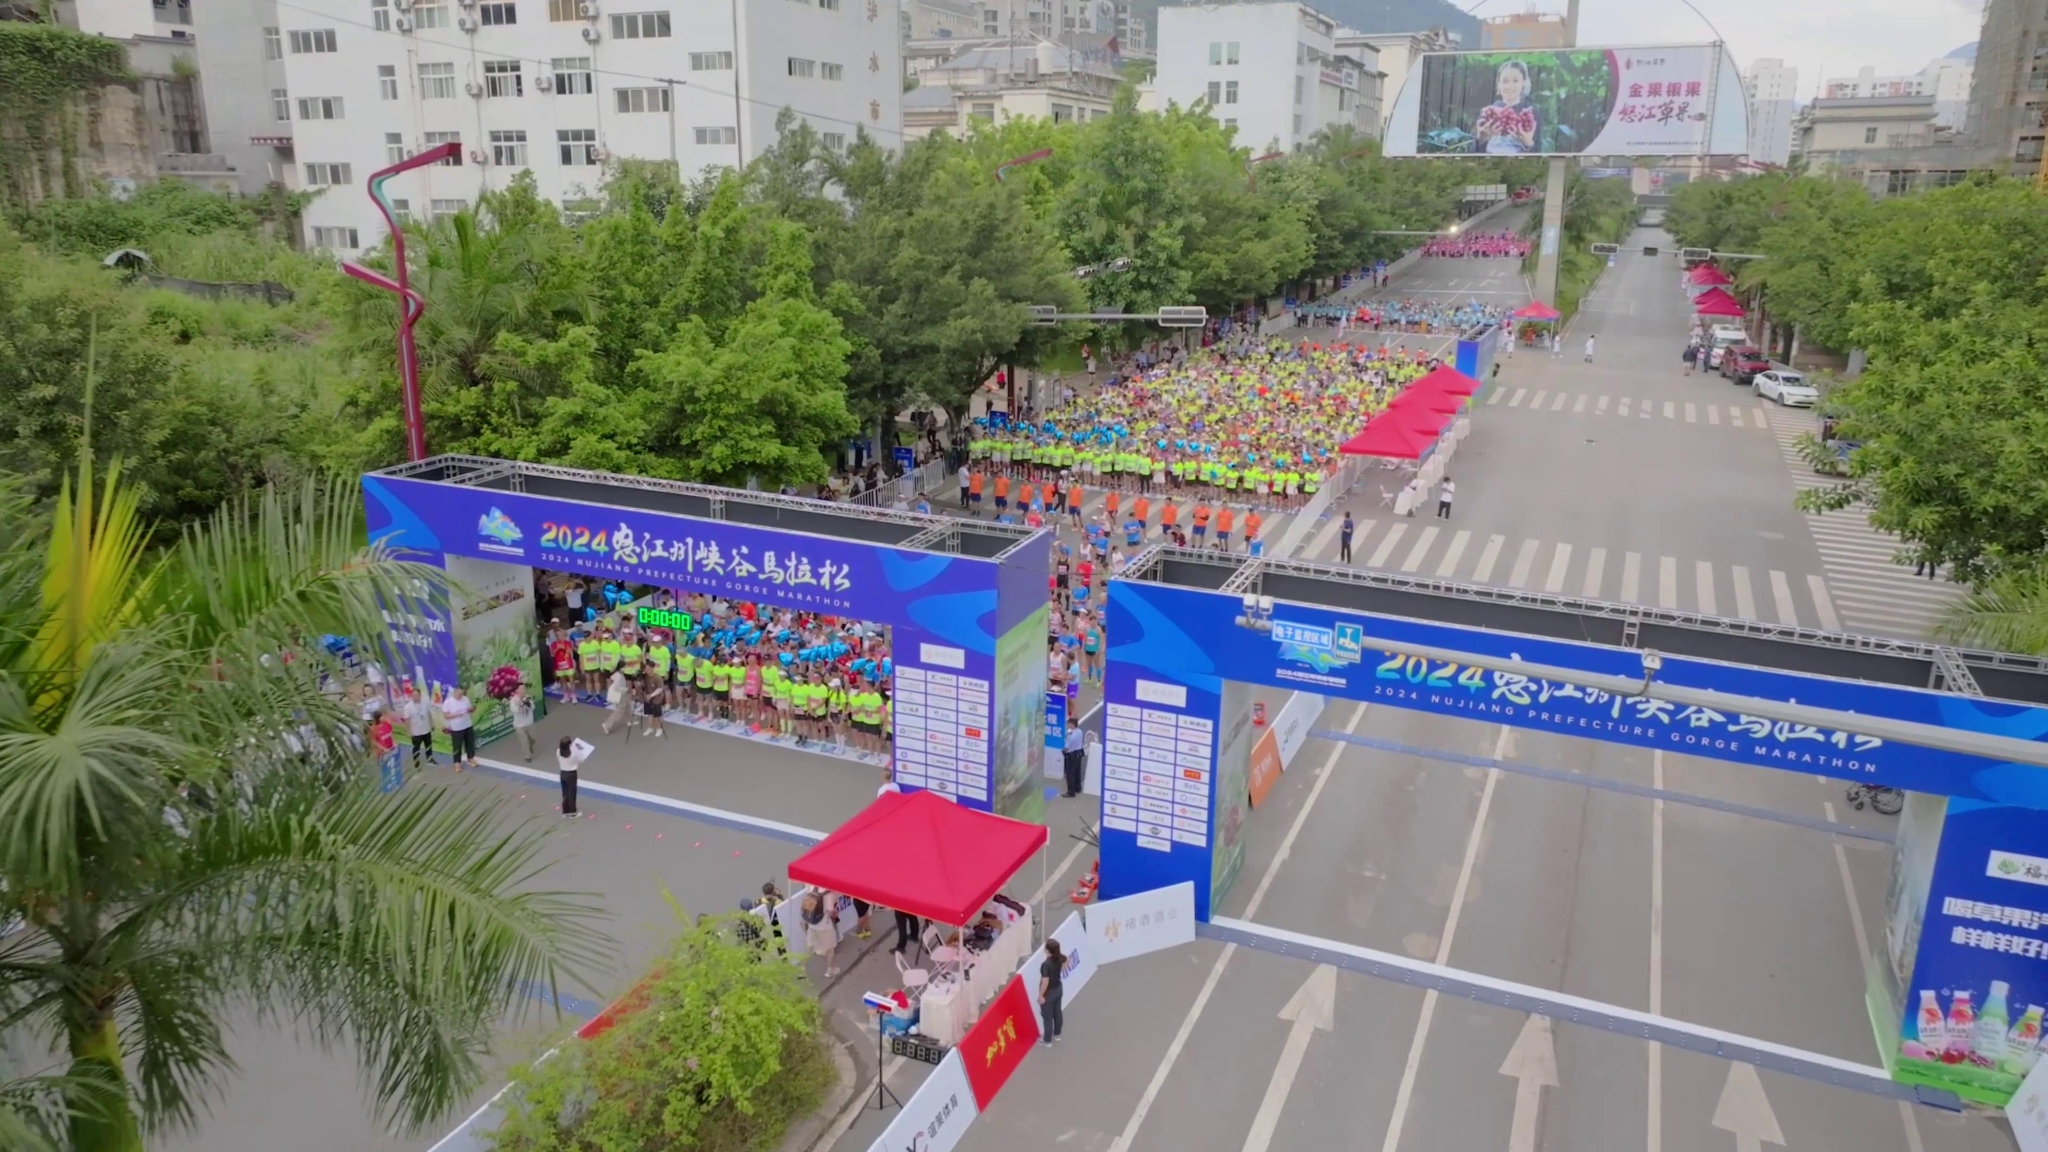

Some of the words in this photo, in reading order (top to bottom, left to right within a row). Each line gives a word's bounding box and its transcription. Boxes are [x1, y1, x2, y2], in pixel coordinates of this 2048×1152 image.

[1628, 81, 1701, 98] 金果银果
[1618, 100, 1691, 127] 怒江草果
[540, 553, 571, 564] 2024
[576, 558, 631, 574] NUJIANG
[637, 568, 718, 588] PREFECTURE
[725, 581, 769, 596] GORGE
[776, 589, 851, 609] MARATHON
[639, 607, 690, 630] 0:00:00
[1275, 625, 1329, 646] 电子监控区域
[1373, 686, 1419, 700] 2024
[1430, 694, 1515, 717] NUJIANG
[1527, 710, 1657, 739] PREFECTURE
[1670, 732, 1740, 752] GORGE
[1753, 745, 1878, 774] MARATHON
